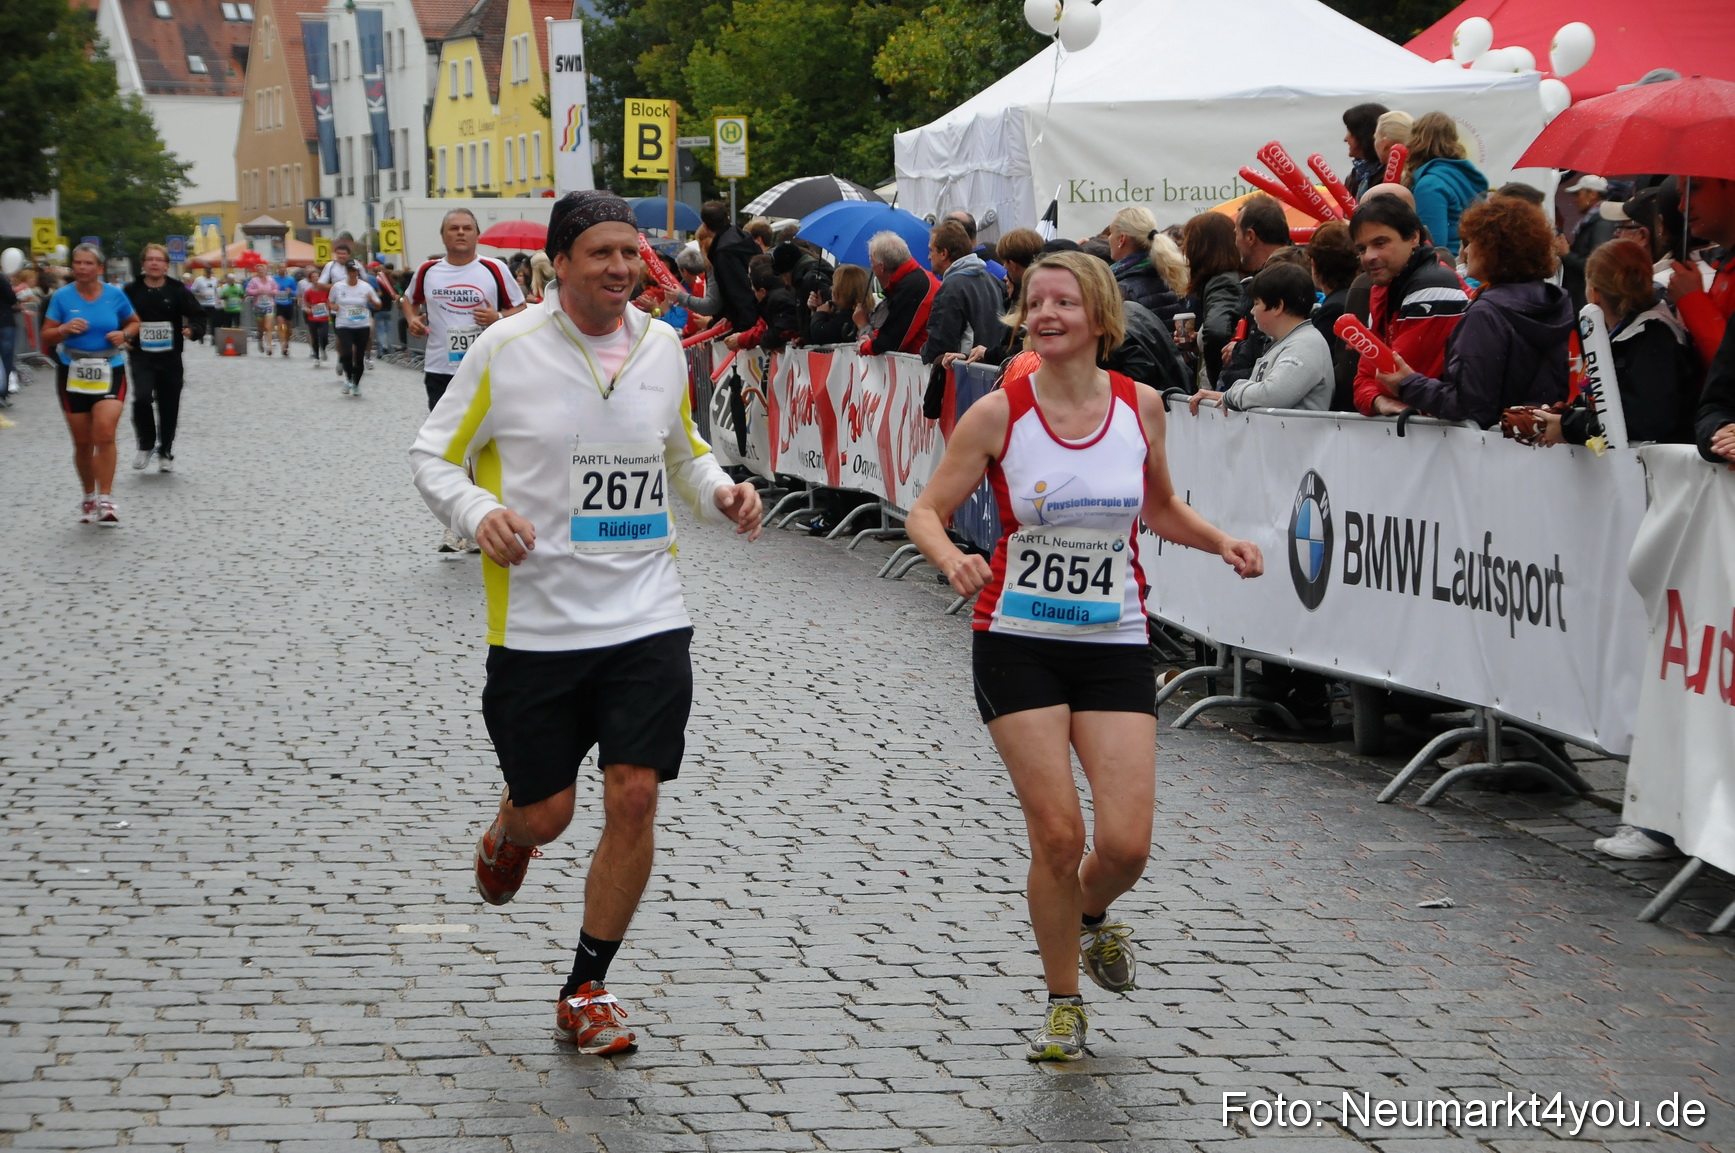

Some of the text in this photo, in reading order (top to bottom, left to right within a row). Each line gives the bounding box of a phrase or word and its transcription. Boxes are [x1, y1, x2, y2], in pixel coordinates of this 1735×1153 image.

[631, 102, 670, 117] Block
[638, 123, 662, 160] B
[1068, 177, 1259, 204] Kinder brauche
[1300, 179, 1322, 206] BKK
[1342, 191, 1359, 211] KK
[1320, 204, 1339, 221] udi
[37, 228, 48, 245] C
[385, 230, 397, 247] C
[318, 245, 328, 258] D
[660, 274, 677, 290] udi
[142, 328, 169, 340] 2382
[450, 334, 481, 351] 297
[77, 367, 102, 380] 580
[572, 453, 660, 465] PARTL Neumarkt
[581, 468, 664, 511] 2674
[1295, 474, 1329, 520] BMW
[1047, 496, 1139, 512] Physiotherapie Wild
[598, 521, 652, 540] Rüdiger
[1011, 532, 1109, 551] PARTL Neumarkt
[1017, 549, 1114, 596] 2654
[1342, 510, 1568, 639] BMW Laufsport
[1031, 600, 1091, 622] Claudia
